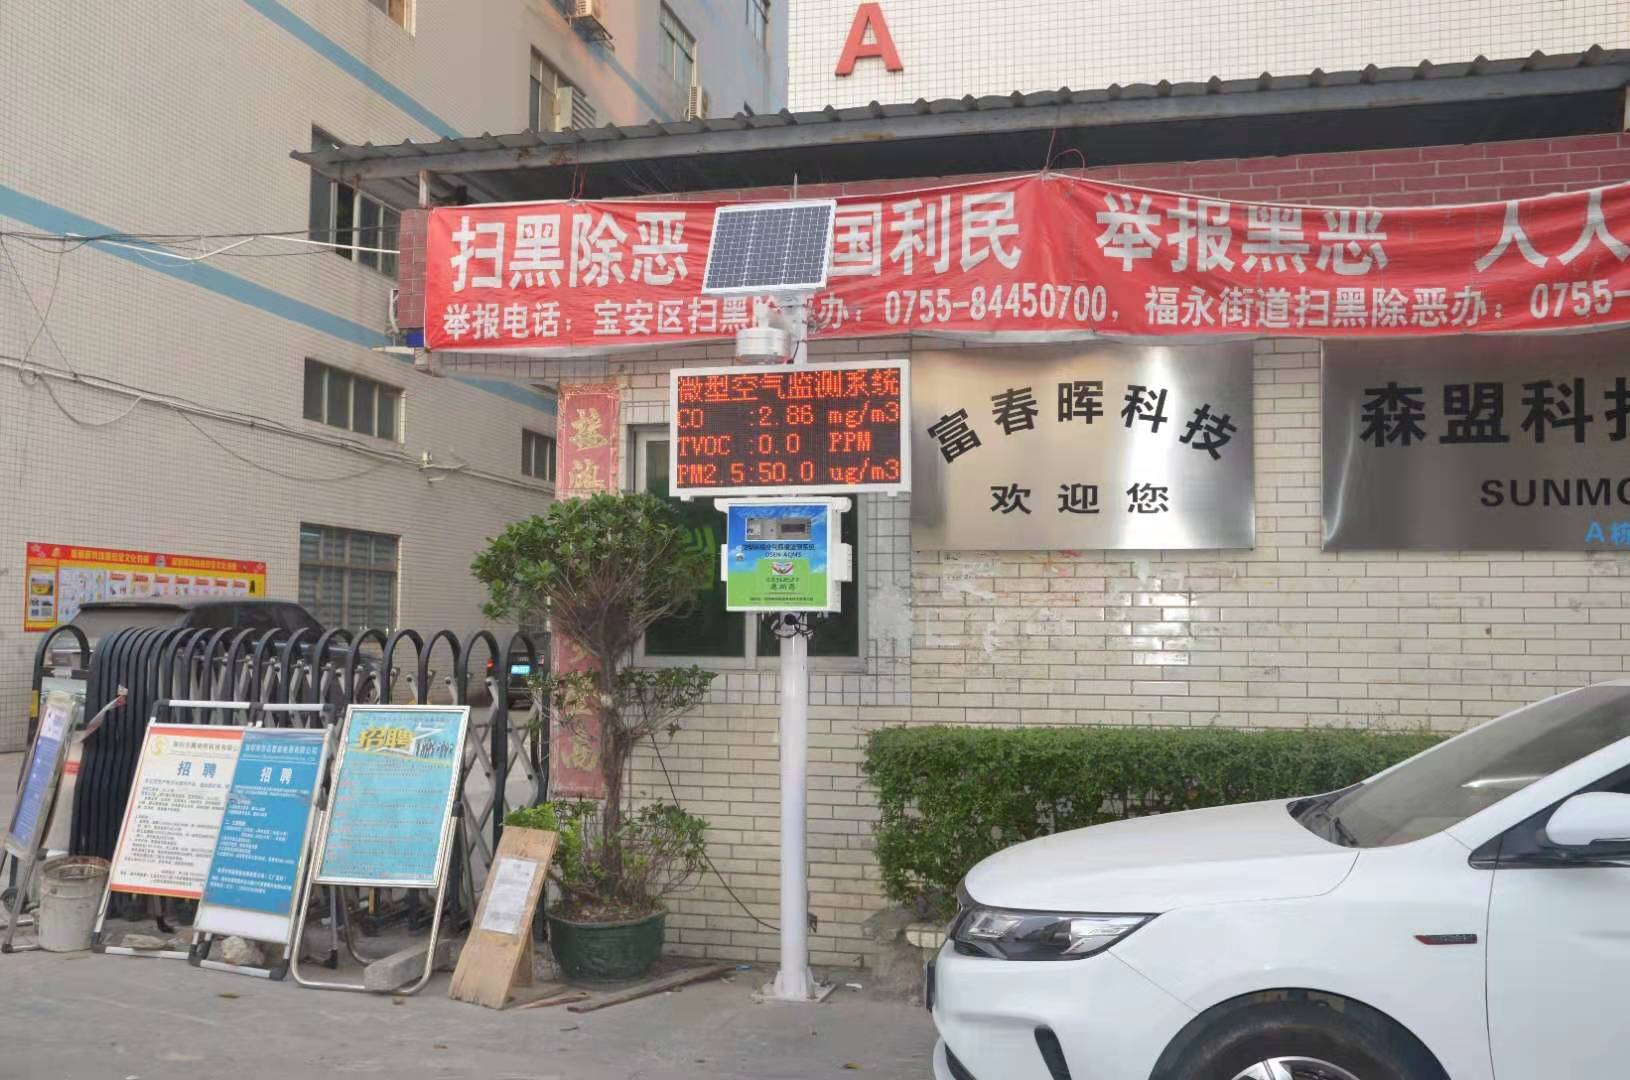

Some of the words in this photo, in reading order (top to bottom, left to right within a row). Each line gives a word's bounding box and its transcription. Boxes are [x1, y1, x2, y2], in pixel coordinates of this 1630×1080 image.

[835, 2, 904, 77] A
[450, 210, 689, 292] 扫黑除恶
[1095, 192, 1388, 276] 举报黑恶
[677, 368, 899, 402] 微型空气监测系统
[827, 400, 899, 428] mg/m3
[927, 380, 1238, 464] 富春晖科技
[677, 435, 731, 456] TVOC
[829, 457, 899, 487] ug/m3
[990, 483, 1169, 514] 欢迎您
